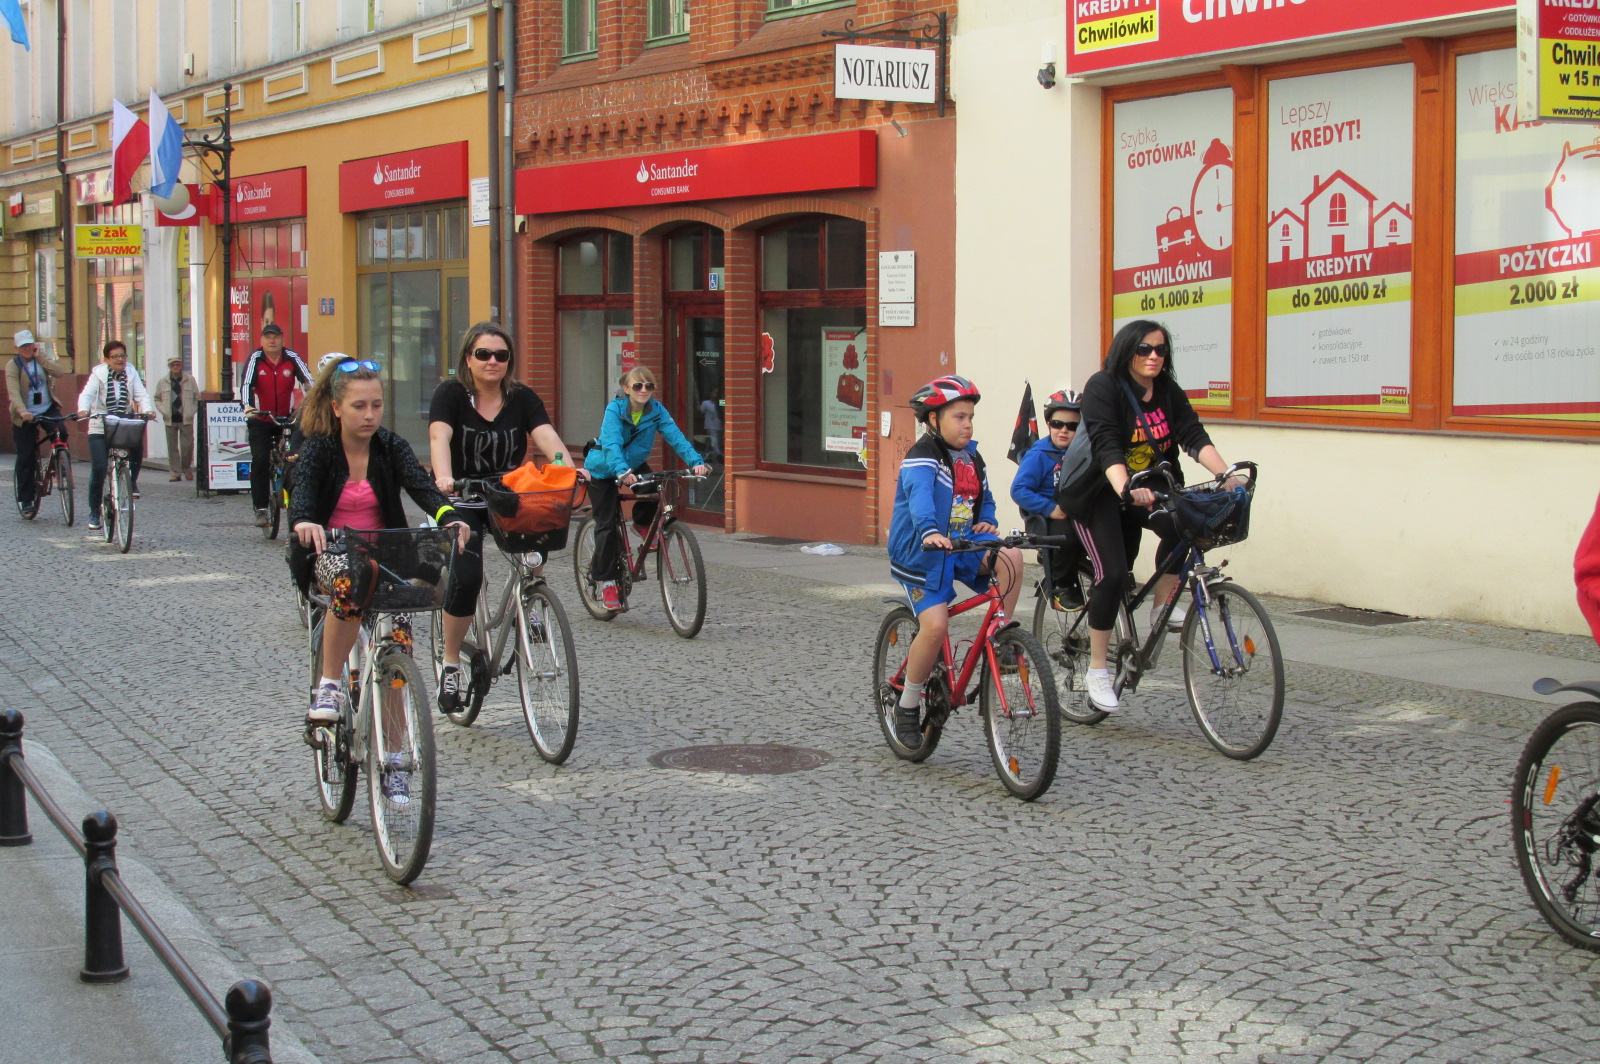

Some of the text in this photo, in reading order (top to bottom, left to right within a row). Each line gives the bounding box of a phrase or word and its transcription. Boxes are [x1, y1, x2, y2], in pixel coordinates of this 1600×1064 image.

[1079, 15, 1153, 45] Chwilówki
[842, 57, 930, 90] NOTARIUSZ
[1559, 73, 1570, 85] w
[1574, 70, 1588, 86] 15
[1281, 101, 1331, 129] Lepszy
[1120, 127, 1158, 151] Szybka
[1291, 119, 1361, 152] KREDYT!
[1127, 139, 1196, 170] GOTÓWKA!
[384, 160, 422, 183] Santander
[650, 158, 698, 181] Santander
[244, 181, 272, 201] Santander
[650, 184, 690, 197] CONSUMER BANK
[103, 226, 128, 238] żak
[95, 245, 141, 256] DARMO!
[1499, 241, 1592, 275] POŻYCZKI
[1133, 259, 1213, 289] CHWILÓWKI
[1306, 252, 1373, 279] KREDYTY
[1140, 285, 1204, 312] do 1.000 zł
[1292, 278, 1387, 308] do 200.000 zł
[1509, 275, 1580, 306] 2.000 zł
